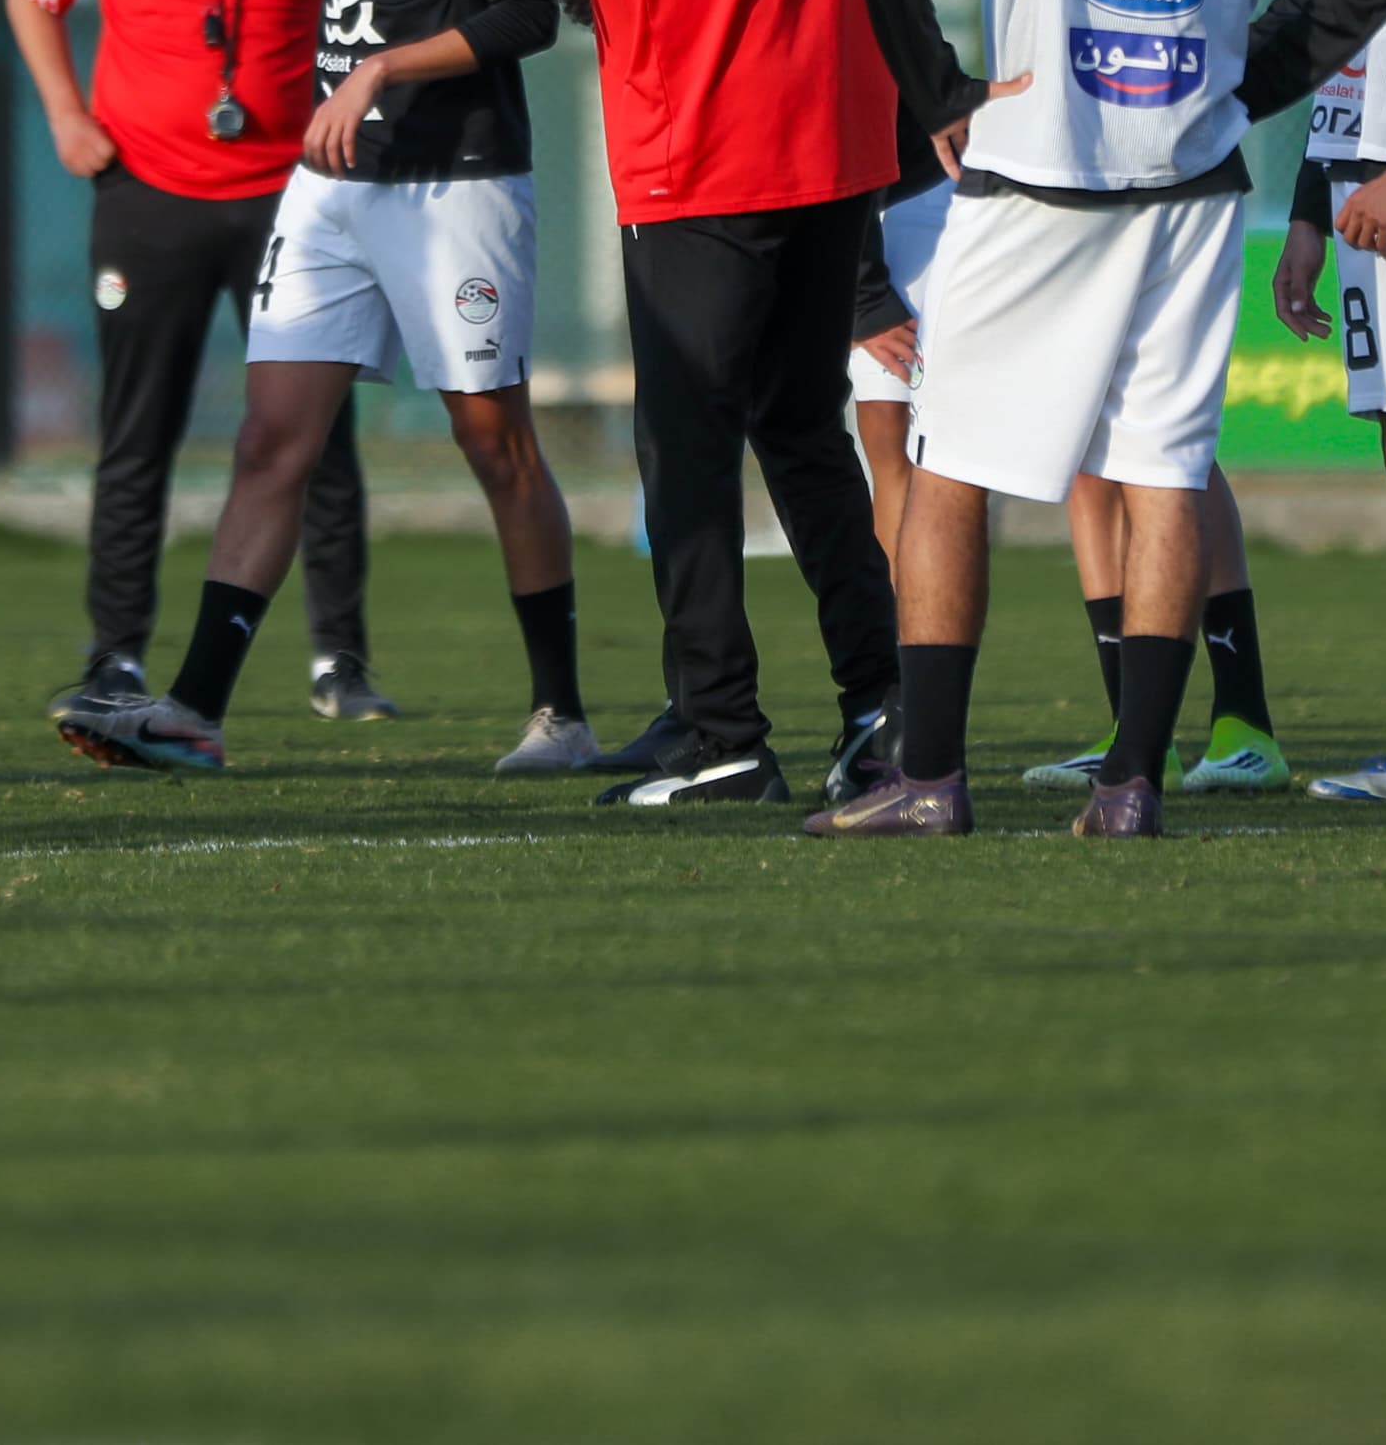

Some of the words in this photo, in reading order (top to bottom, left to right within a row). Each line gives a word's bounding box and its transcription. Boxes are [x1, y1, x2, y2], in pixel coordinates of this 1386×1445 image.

[1075, 37, 1199, 76] دانون
[1343, 286, 1379, 371] 8
[465, 349, 497, 363] PUMA
